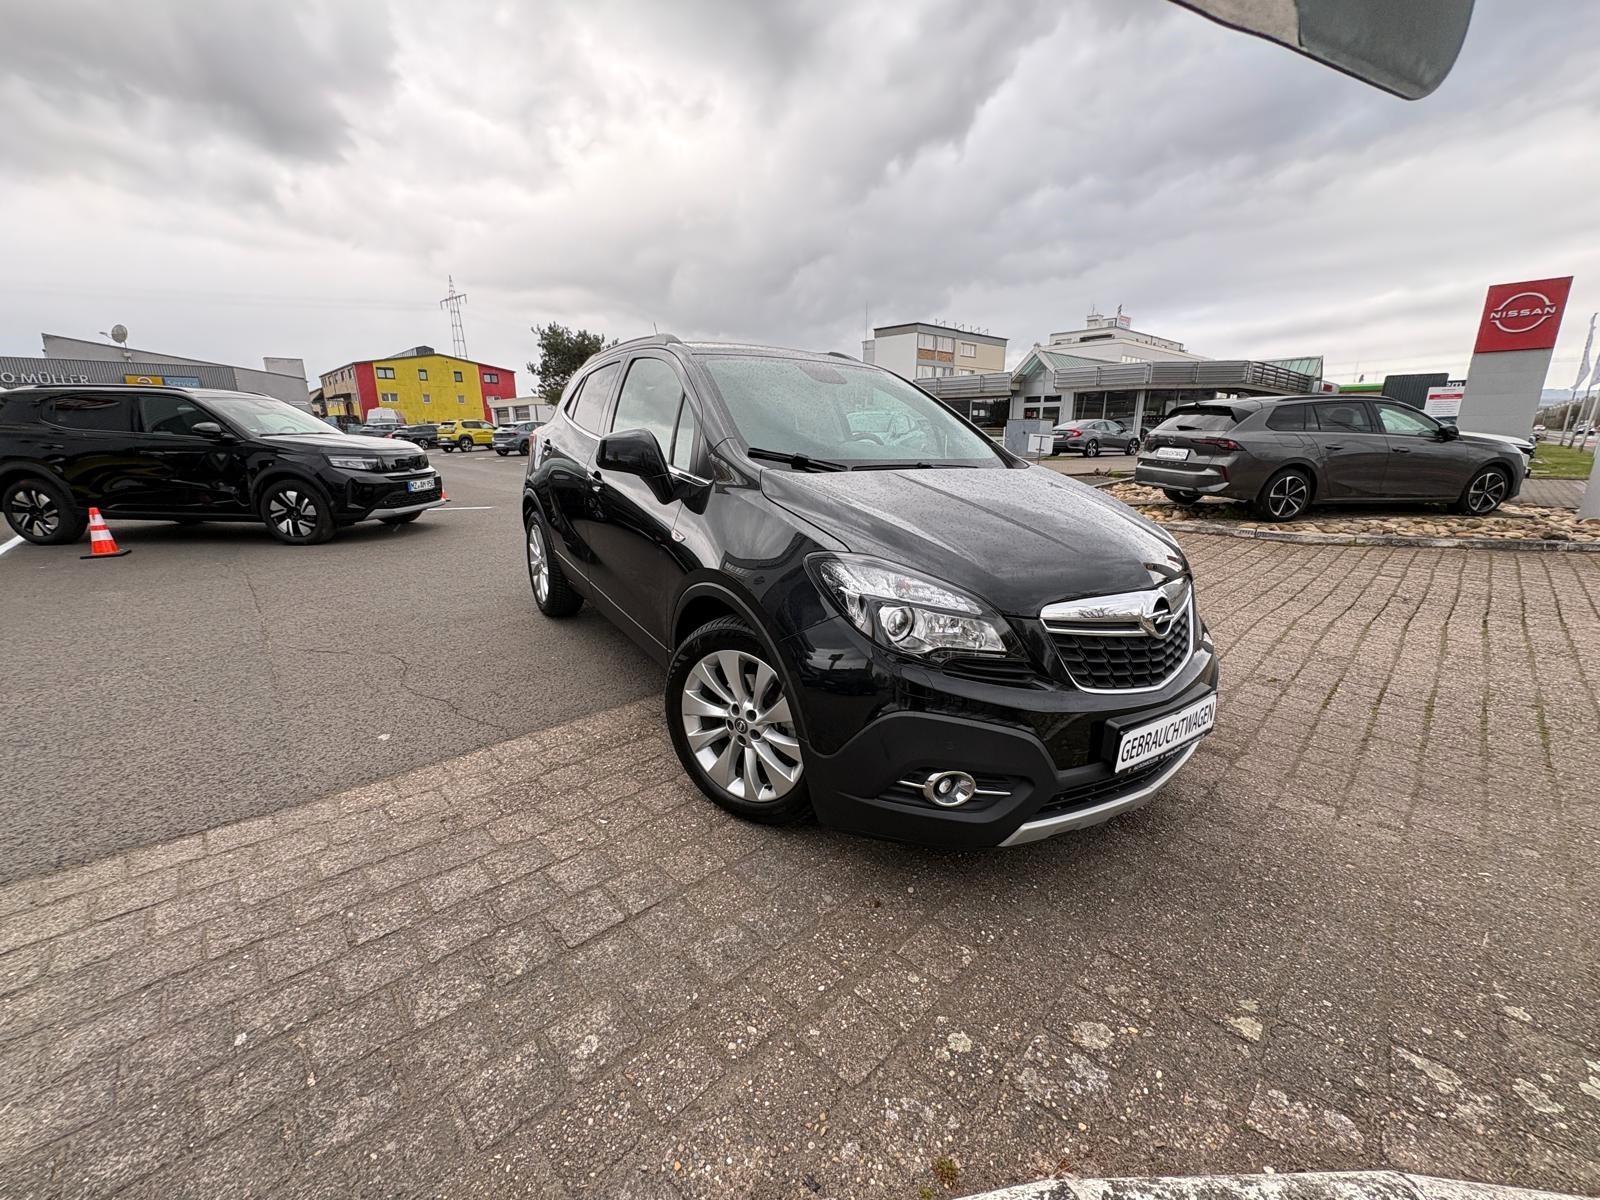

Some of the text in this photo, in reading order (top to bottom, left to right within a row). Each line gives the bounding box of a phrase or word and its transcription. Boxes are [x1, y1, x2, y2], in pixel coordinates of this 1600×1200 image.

[1490, 306, 1556, 319] NISSAN
[20, 371, 90, 385] MÜLLER
[1121, 702, 1215, 762] GEBRAUCHTWAGEN
